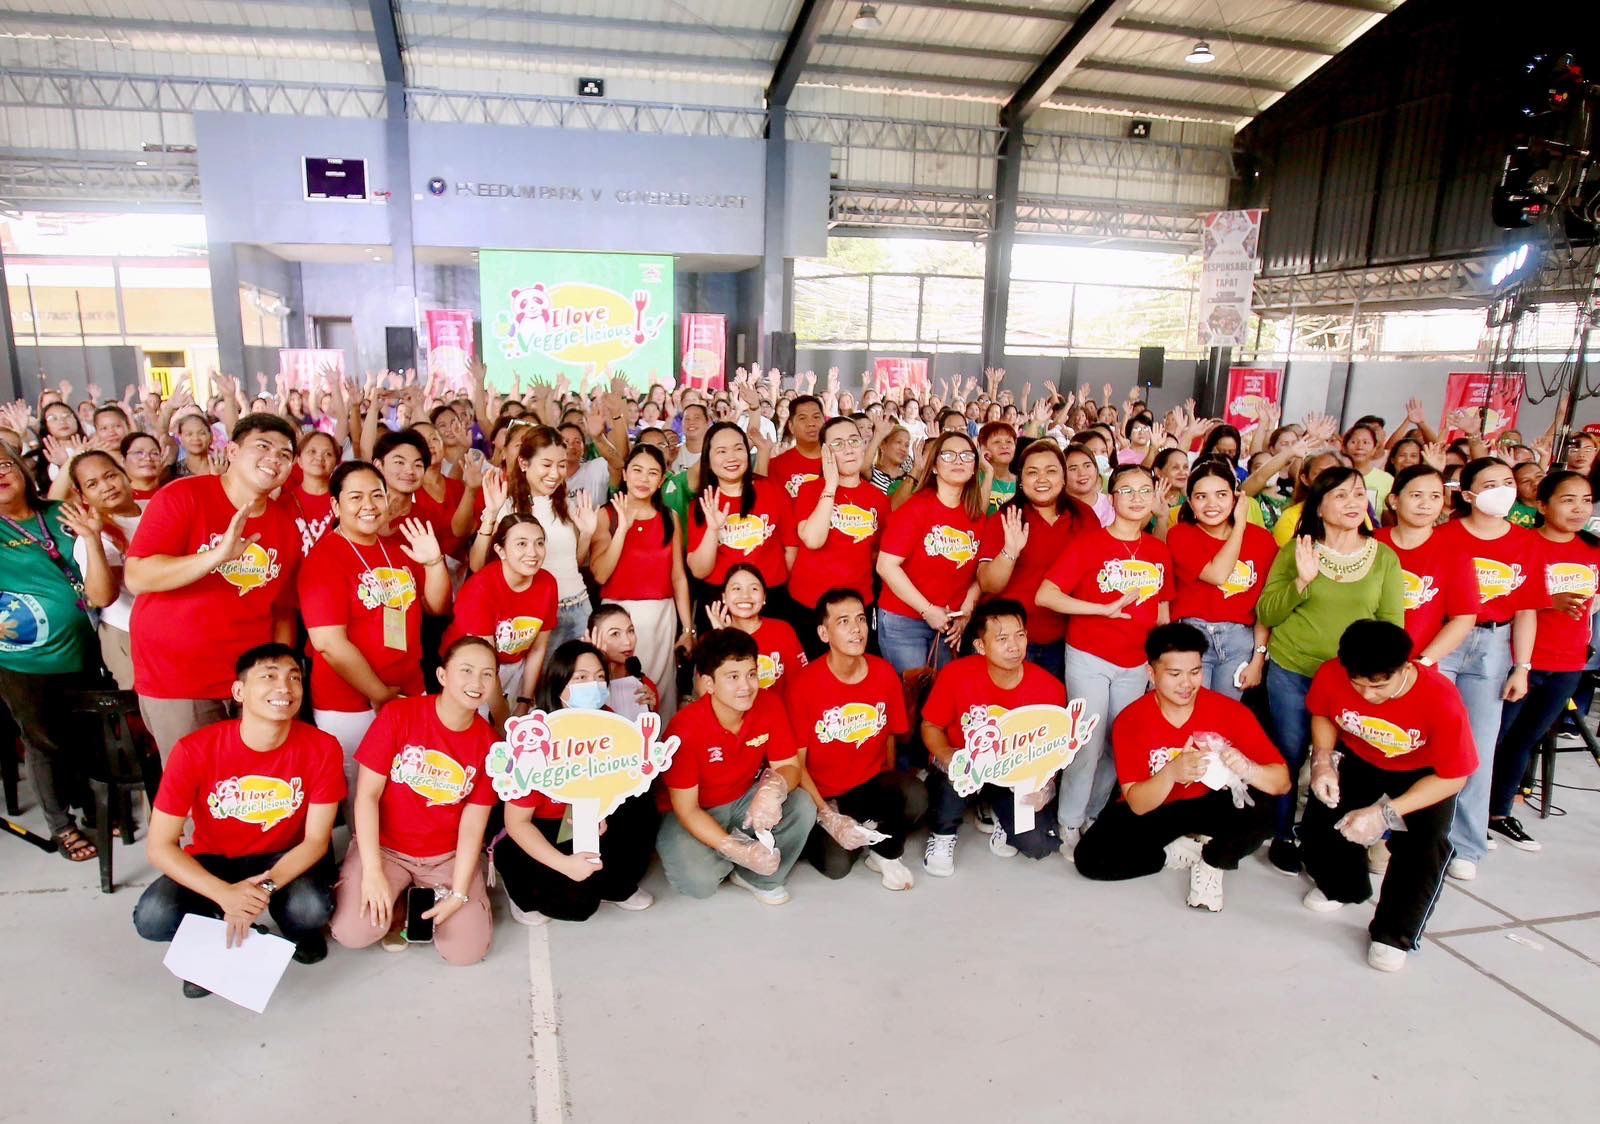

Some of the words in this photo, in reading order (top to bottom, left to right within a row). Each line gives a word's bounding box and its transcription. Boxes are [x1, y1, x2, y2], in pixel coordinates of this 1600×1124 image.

[552, 310, 560, 328] I
[564, 307, 608, 325] love
[516, 325, 632, 353] Veggie-licious
[1560, 573, 1581, 582] love
[1001, 738, 1009, 756] I
[1013, 725, 1047, 750] love
[1369, 726, 1393, 737] love
[552, 740, 561, 761] I
[567, 736, 611, 758] love
[971, 735, 1067, 784] Veggie-licious
[398, 769, 461, 791] Veggie-licious
[427, 765, 451, 778] love
[514, 754, 639, 790] Veggie-licious
[249, 789, 275, 800] love
[219, 800, 291, 817] Veggie-licious
